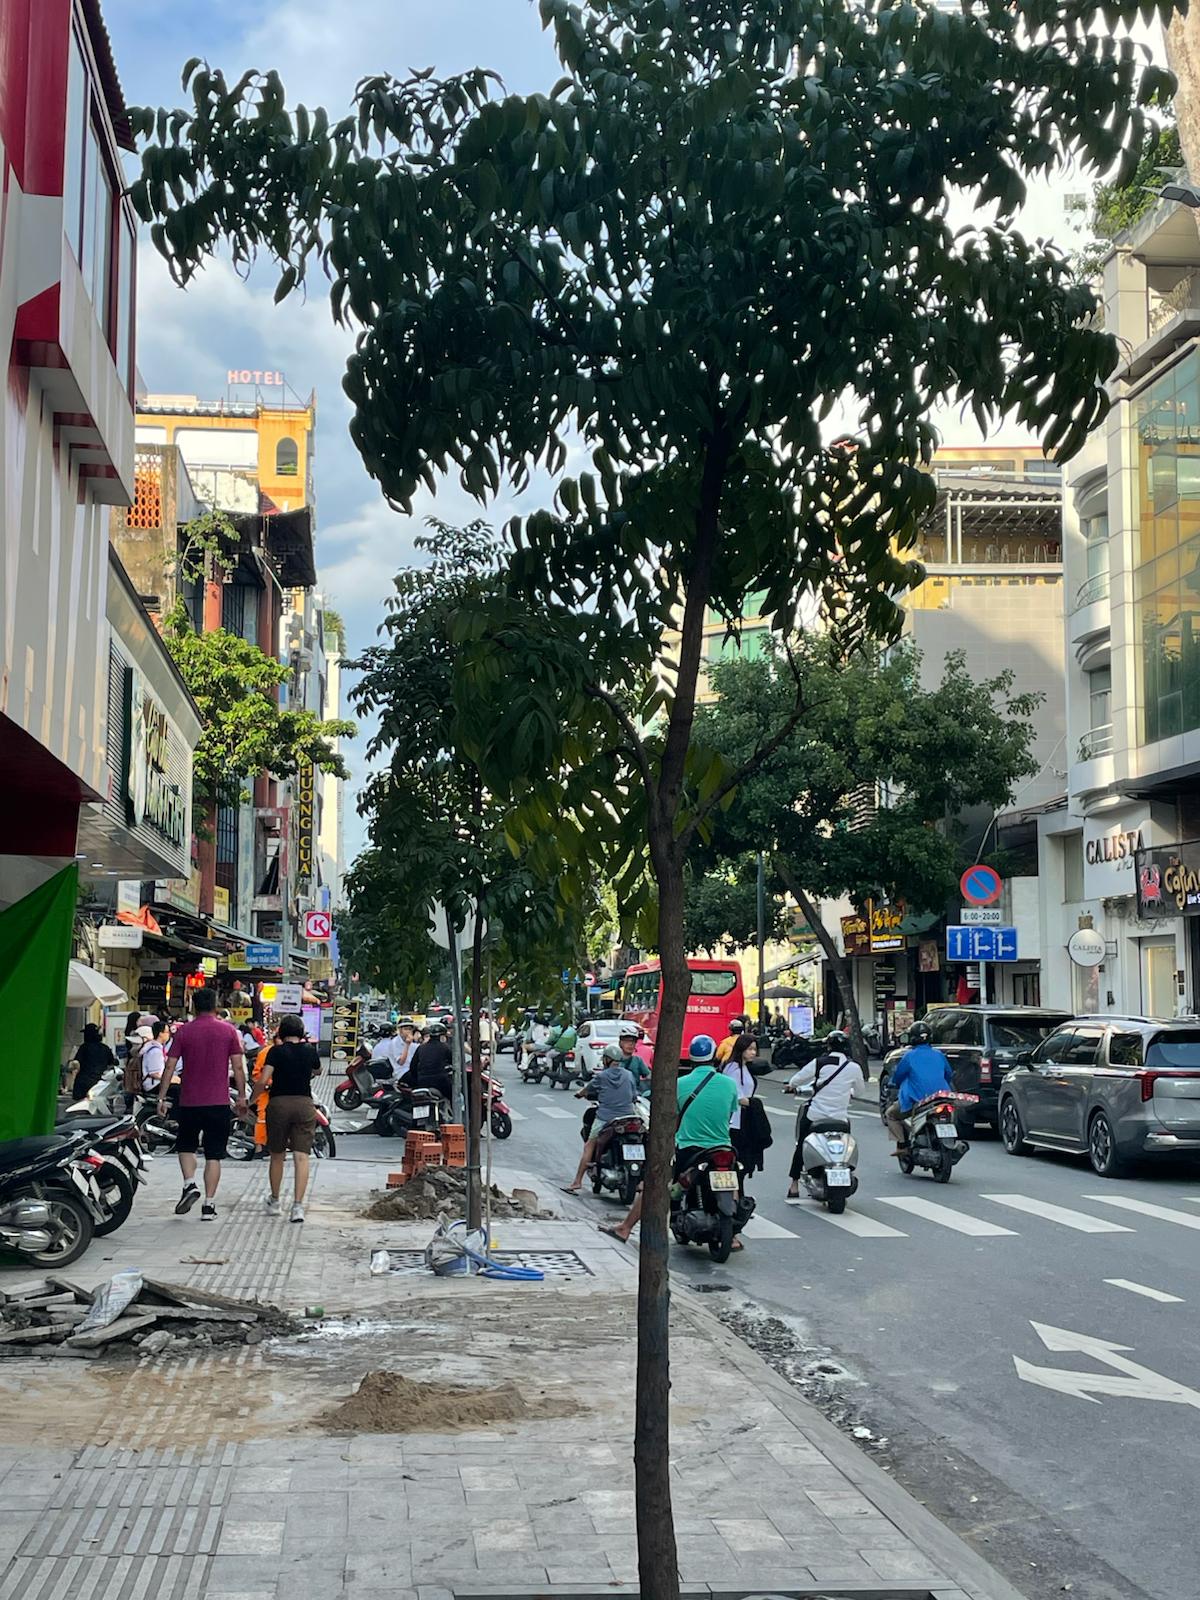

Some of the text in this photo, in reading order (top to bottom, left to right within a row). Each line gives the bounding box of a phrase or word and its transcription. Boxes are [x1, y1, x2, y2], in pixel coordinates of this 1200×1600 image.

[228, 370, 284, 385] HOTEL
[1086, 829, 1145, 866] CALISTA
[1164, 865, 1199, 908] Cajun
[963, 912, 1000, 921] 6:00-20:00
[1072, 943, 1102, 951] CALISTA
